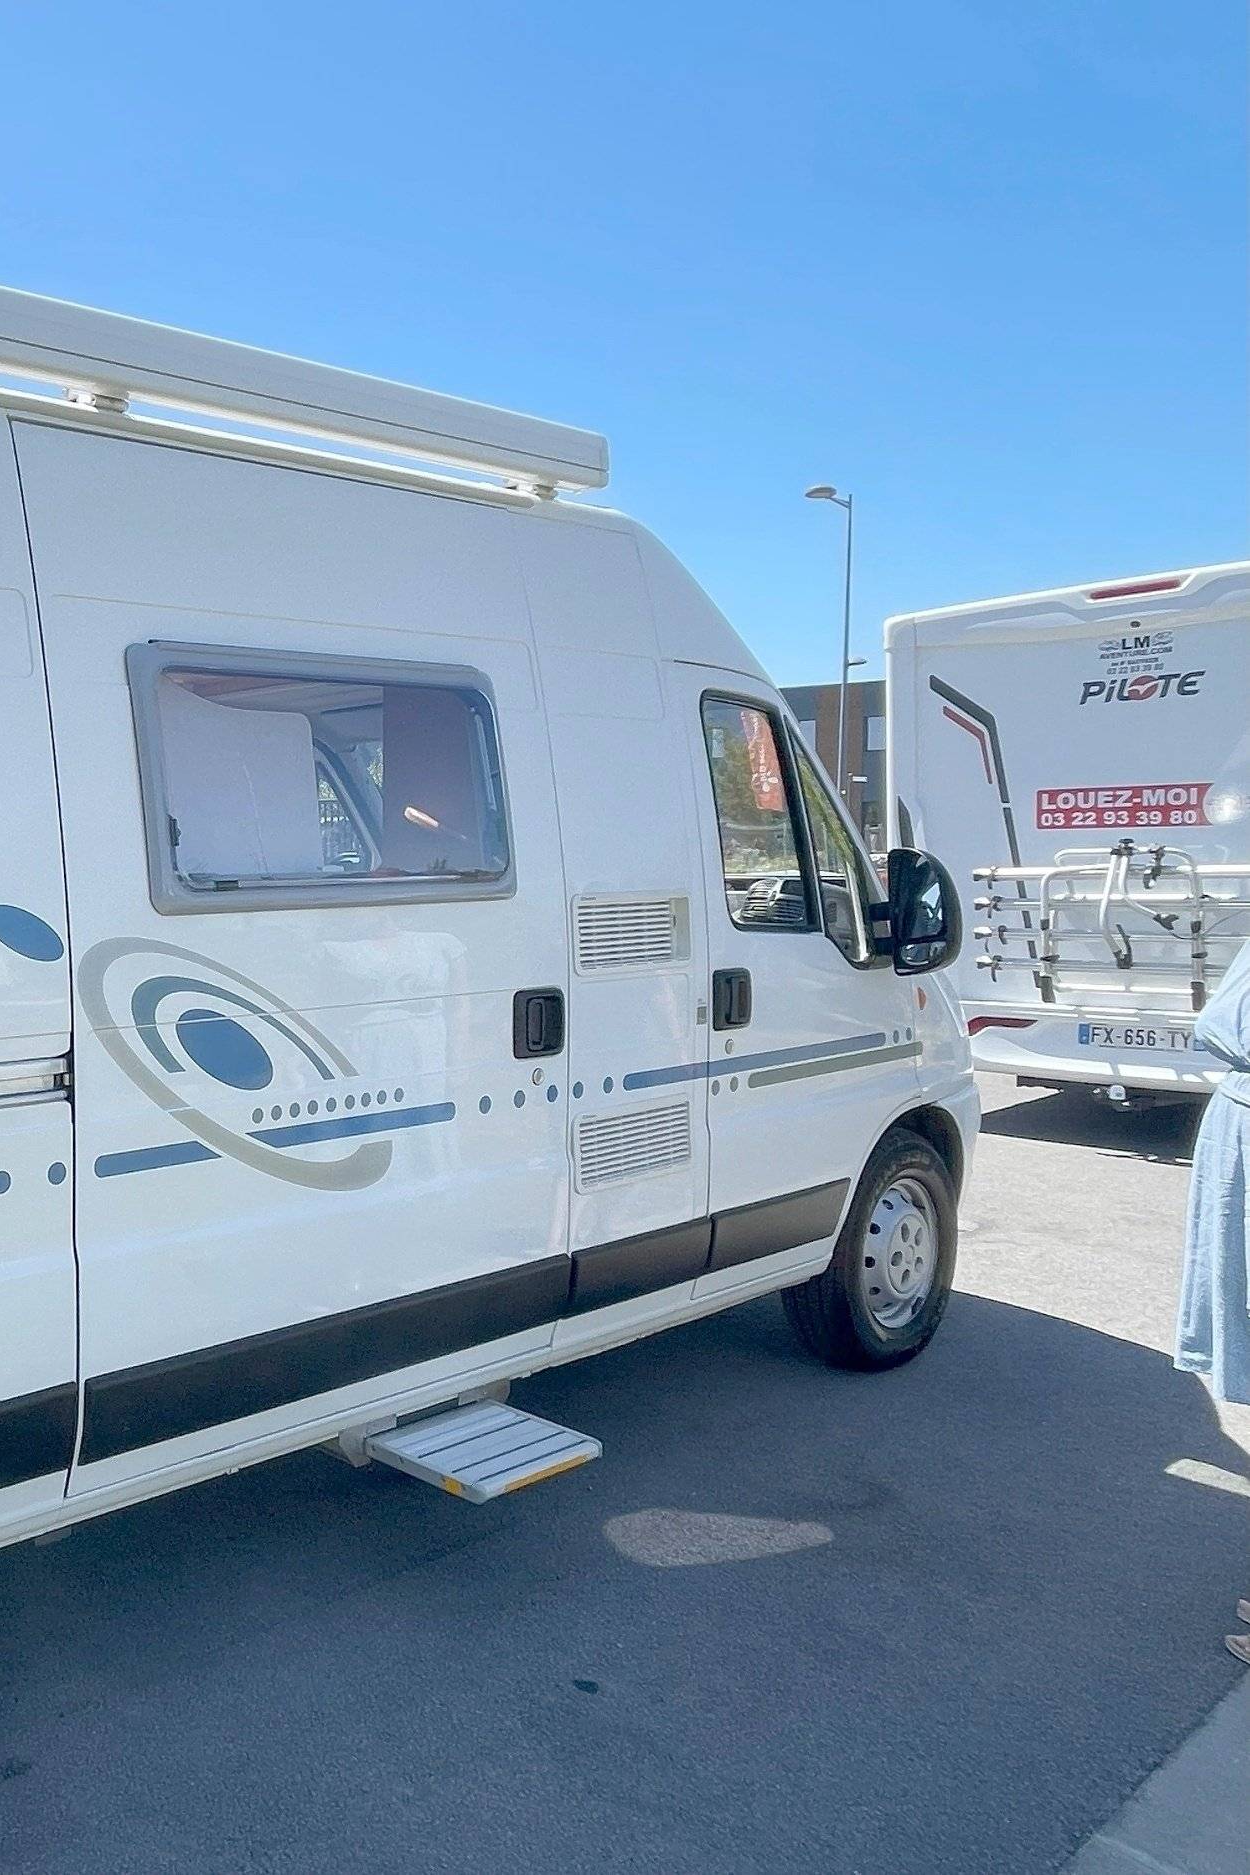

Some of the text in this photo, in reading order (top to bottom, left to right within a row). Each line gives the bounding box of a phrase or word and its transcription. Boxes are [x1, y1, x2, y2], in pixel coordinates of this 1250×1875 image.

[1121, 636, 1151, 650] LM
[1041, 787, 1198, 809] LOUEZ-MOI
[1041, 810, 1197, 826] 03 22 93 39 80
[1091, 1027, 1192, 1048] FX-656-TY
